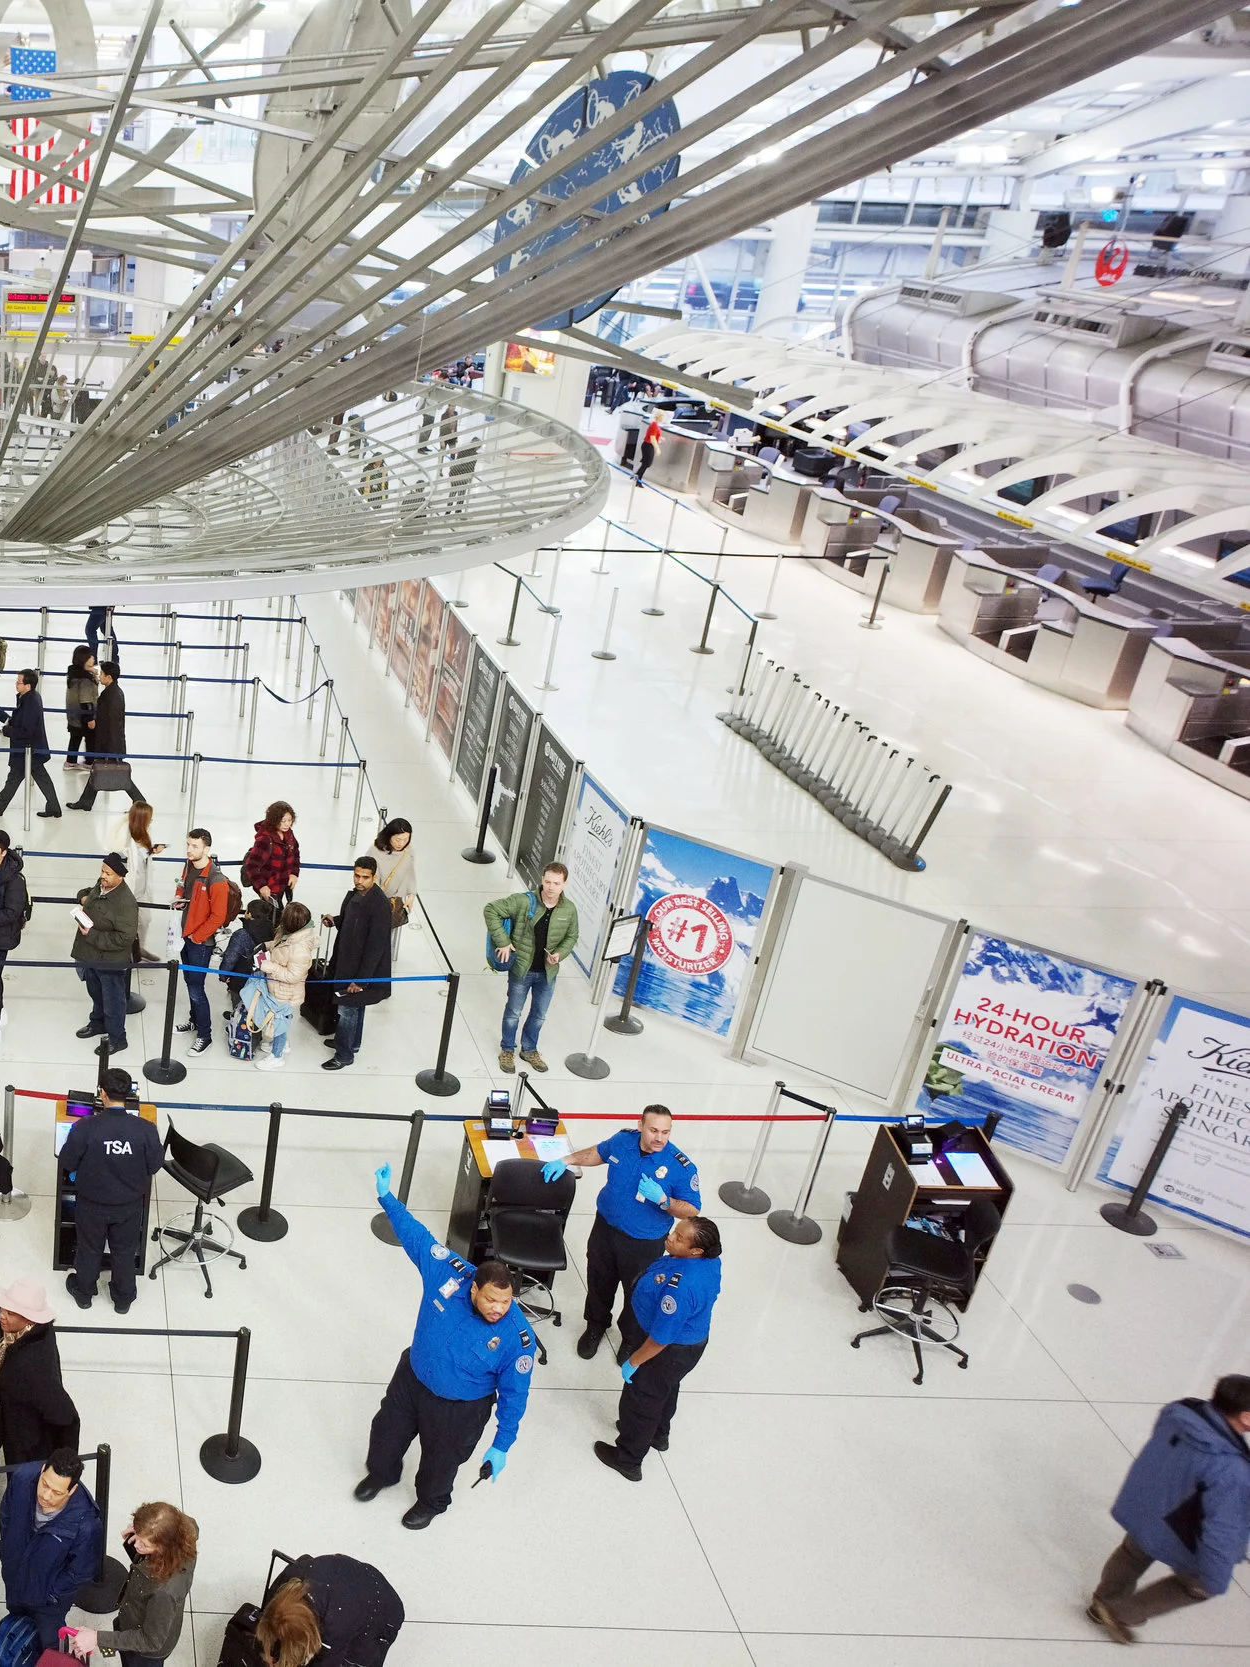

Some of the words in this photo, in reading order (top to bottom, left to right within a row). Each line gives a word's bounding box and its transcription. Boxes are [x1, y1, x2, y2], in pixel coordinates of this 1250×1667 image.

[585, 805, 613, 848] Kiehl's
[654, 900, 674, 917] OUR
[673, 897, 700, 908] BEST
[700, 903, 729, 940] SELLING
[667, 916, 709, 954] #1
[652, 938, 718, 970] MOISTURIZER
[953, 1008, 1098, 1068] HYDRATION
[976, 997, 1086, 1044] 24-HOUR
[946, 1051, 983, 1071] ULTRA
[985, 1066, 1029, 1087] FACIAL
[1030, 1082, 1076, 1103] CREAM
[1203, 1073, 1239, 1089] SINCE
[1151, 1088, 1250, 1131] APOTHEC
[1190, 1083, 1250, 1114] FINES
[103, 1140, 133, 1155] TSA
[1174, 1188, 1191, 1200] DUTY
[1190, 1194, 1206, 1206] FREE
